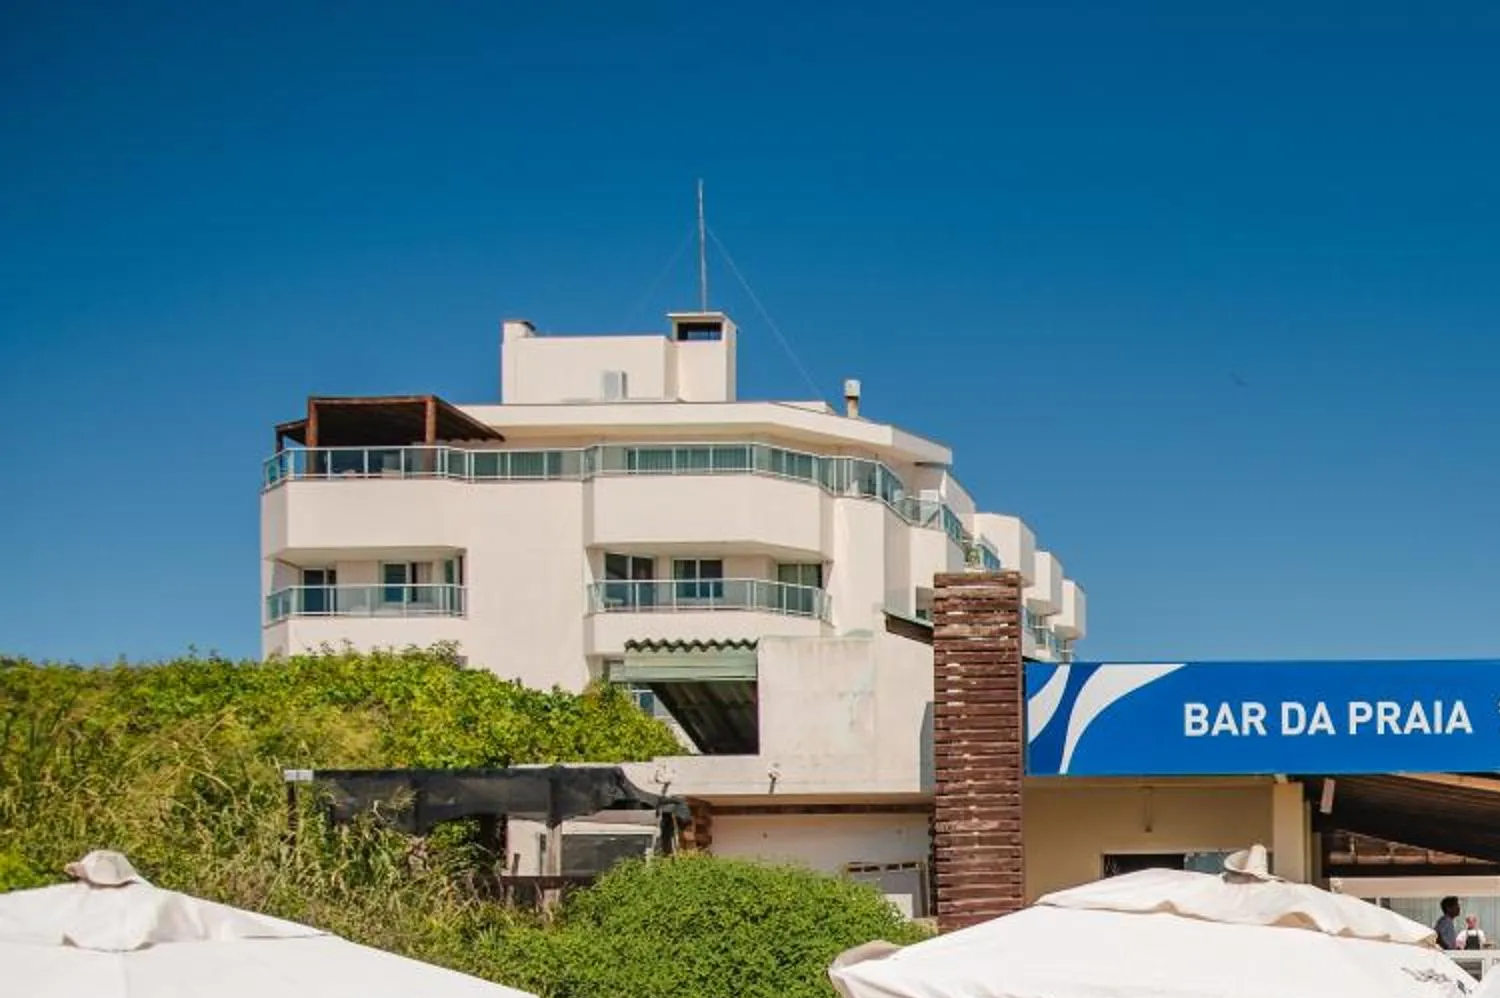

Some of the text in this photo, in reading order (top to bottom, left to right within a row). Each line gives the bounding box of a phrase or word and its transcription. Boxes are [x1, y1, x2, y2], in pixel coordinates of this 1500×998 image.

[1184, 699, 1474, 736] BAR DA PRAIA
